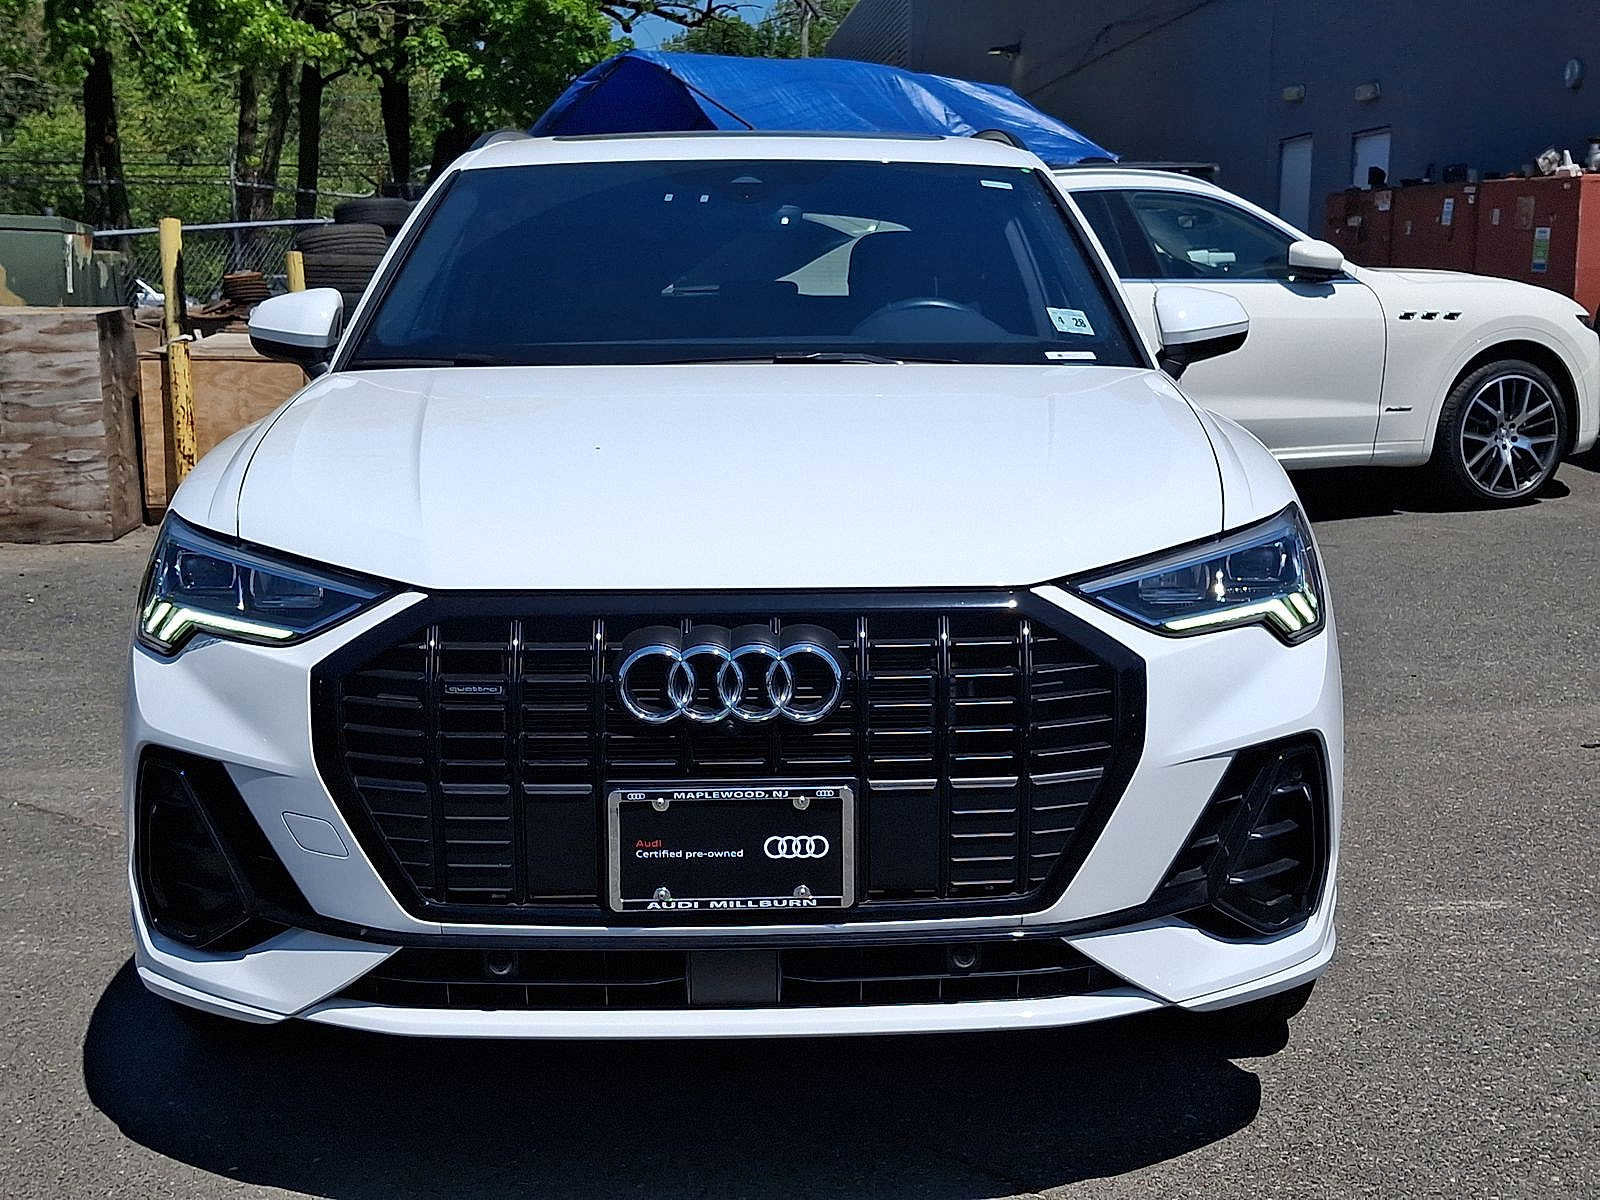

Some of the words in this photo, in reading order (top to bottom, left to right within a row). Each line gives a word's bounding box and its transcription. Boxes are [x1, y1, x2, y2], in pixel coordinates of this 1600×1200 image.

[1072, 317, 1087, 328] 28
[673, 790, 769, 799] MAPLEWOOD,
[772, 790, 789, 798] NJ
[635, 839, 662, 848] Audi
[635, 849, 683, 859] Certified
[685, 849, 744, 860] pre-owned
[647, 901, 699, 910] AUDI
[709, 899, 817, 909] MILLBURN
